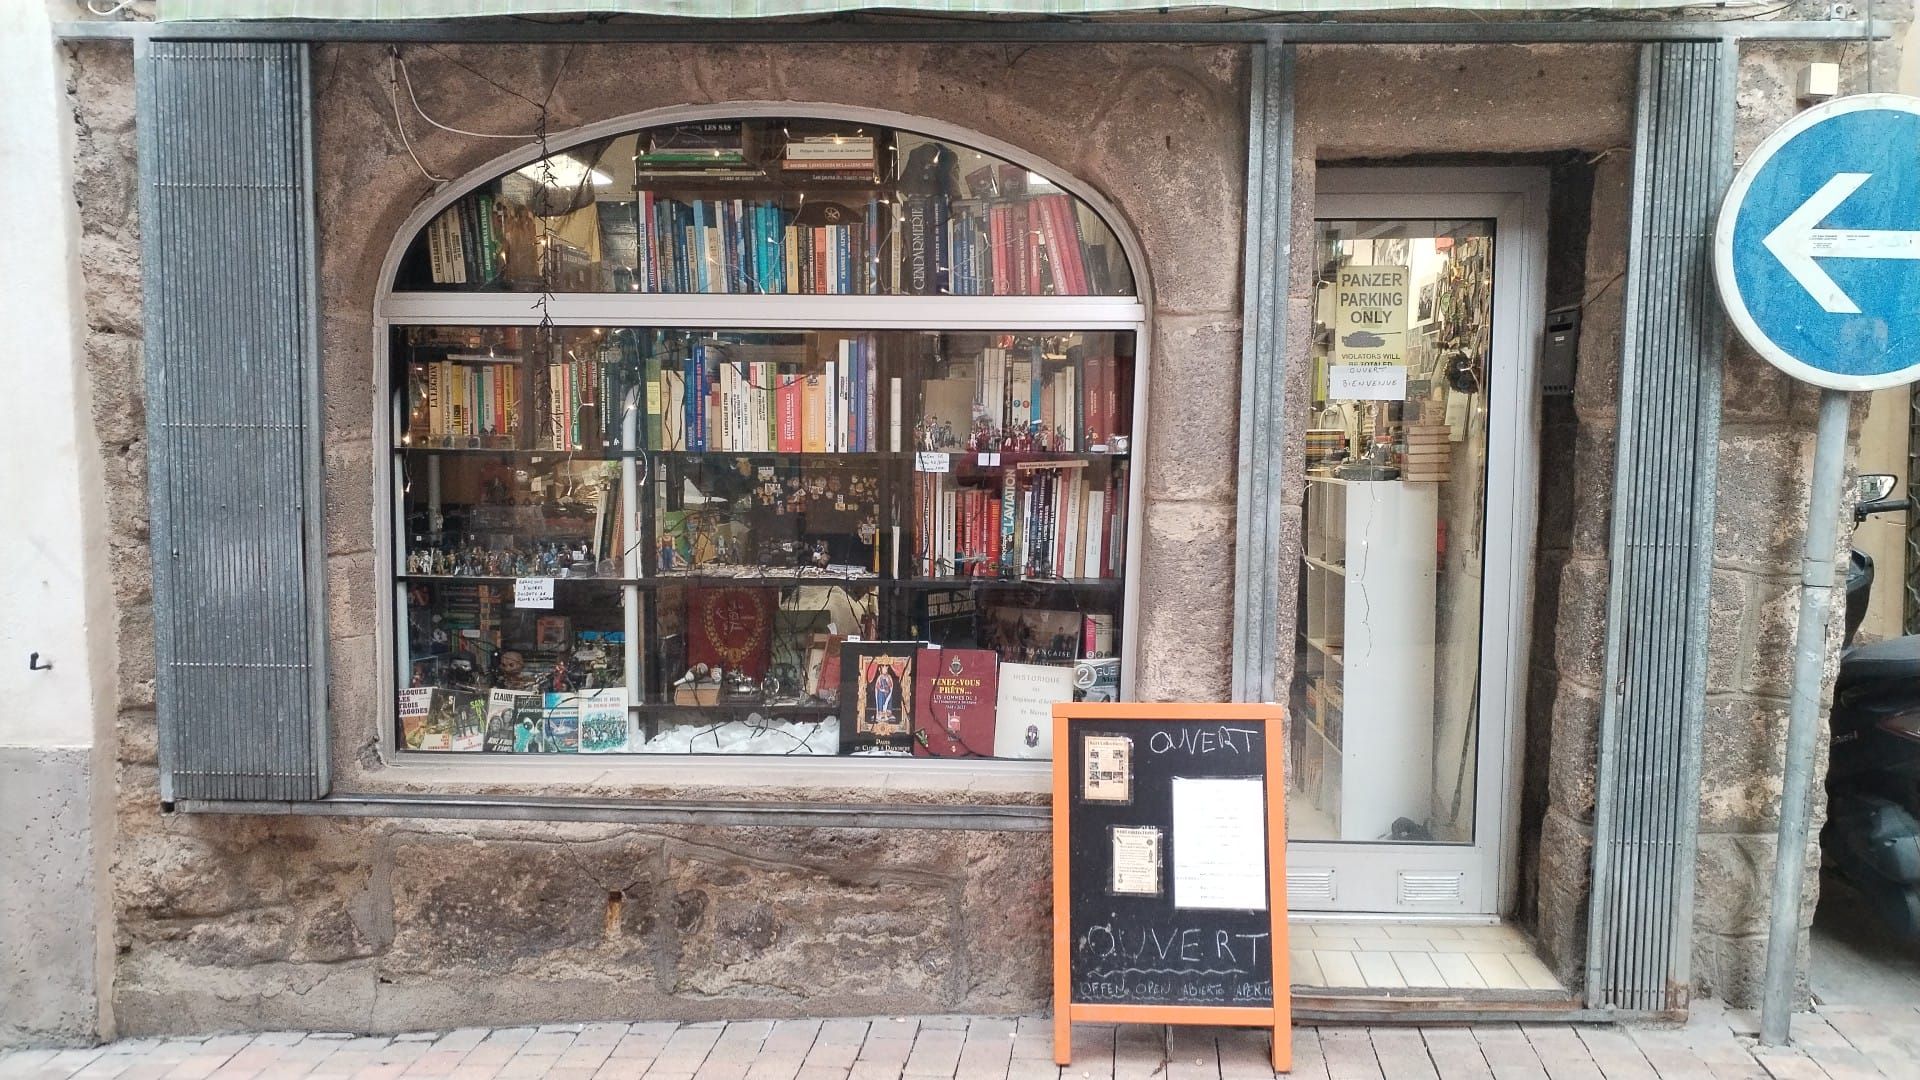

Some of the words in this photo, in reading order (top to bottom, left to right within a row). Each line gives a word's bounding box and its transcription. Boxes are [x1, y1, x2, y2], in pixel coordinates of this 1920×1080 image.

[911, 208, 925, 290] GENDARMERIE
[1341, 273, 1402, 287] PANZER
[1340, 292, 1403, 307] PARKING
[1350, 311, 1393, 324] ONLY
[1002, 469, 1016, 527] L'AVIATION
[931, 679, 981, 687] TENEZ-VOUS
[1088, 925, 1269, 966] OUVERT
[1081, 979, 1126, 996] OFFEN
[1135, 982, 1172, 996] OPEN
[1183, 983, 1224, 997] ABIERTO
